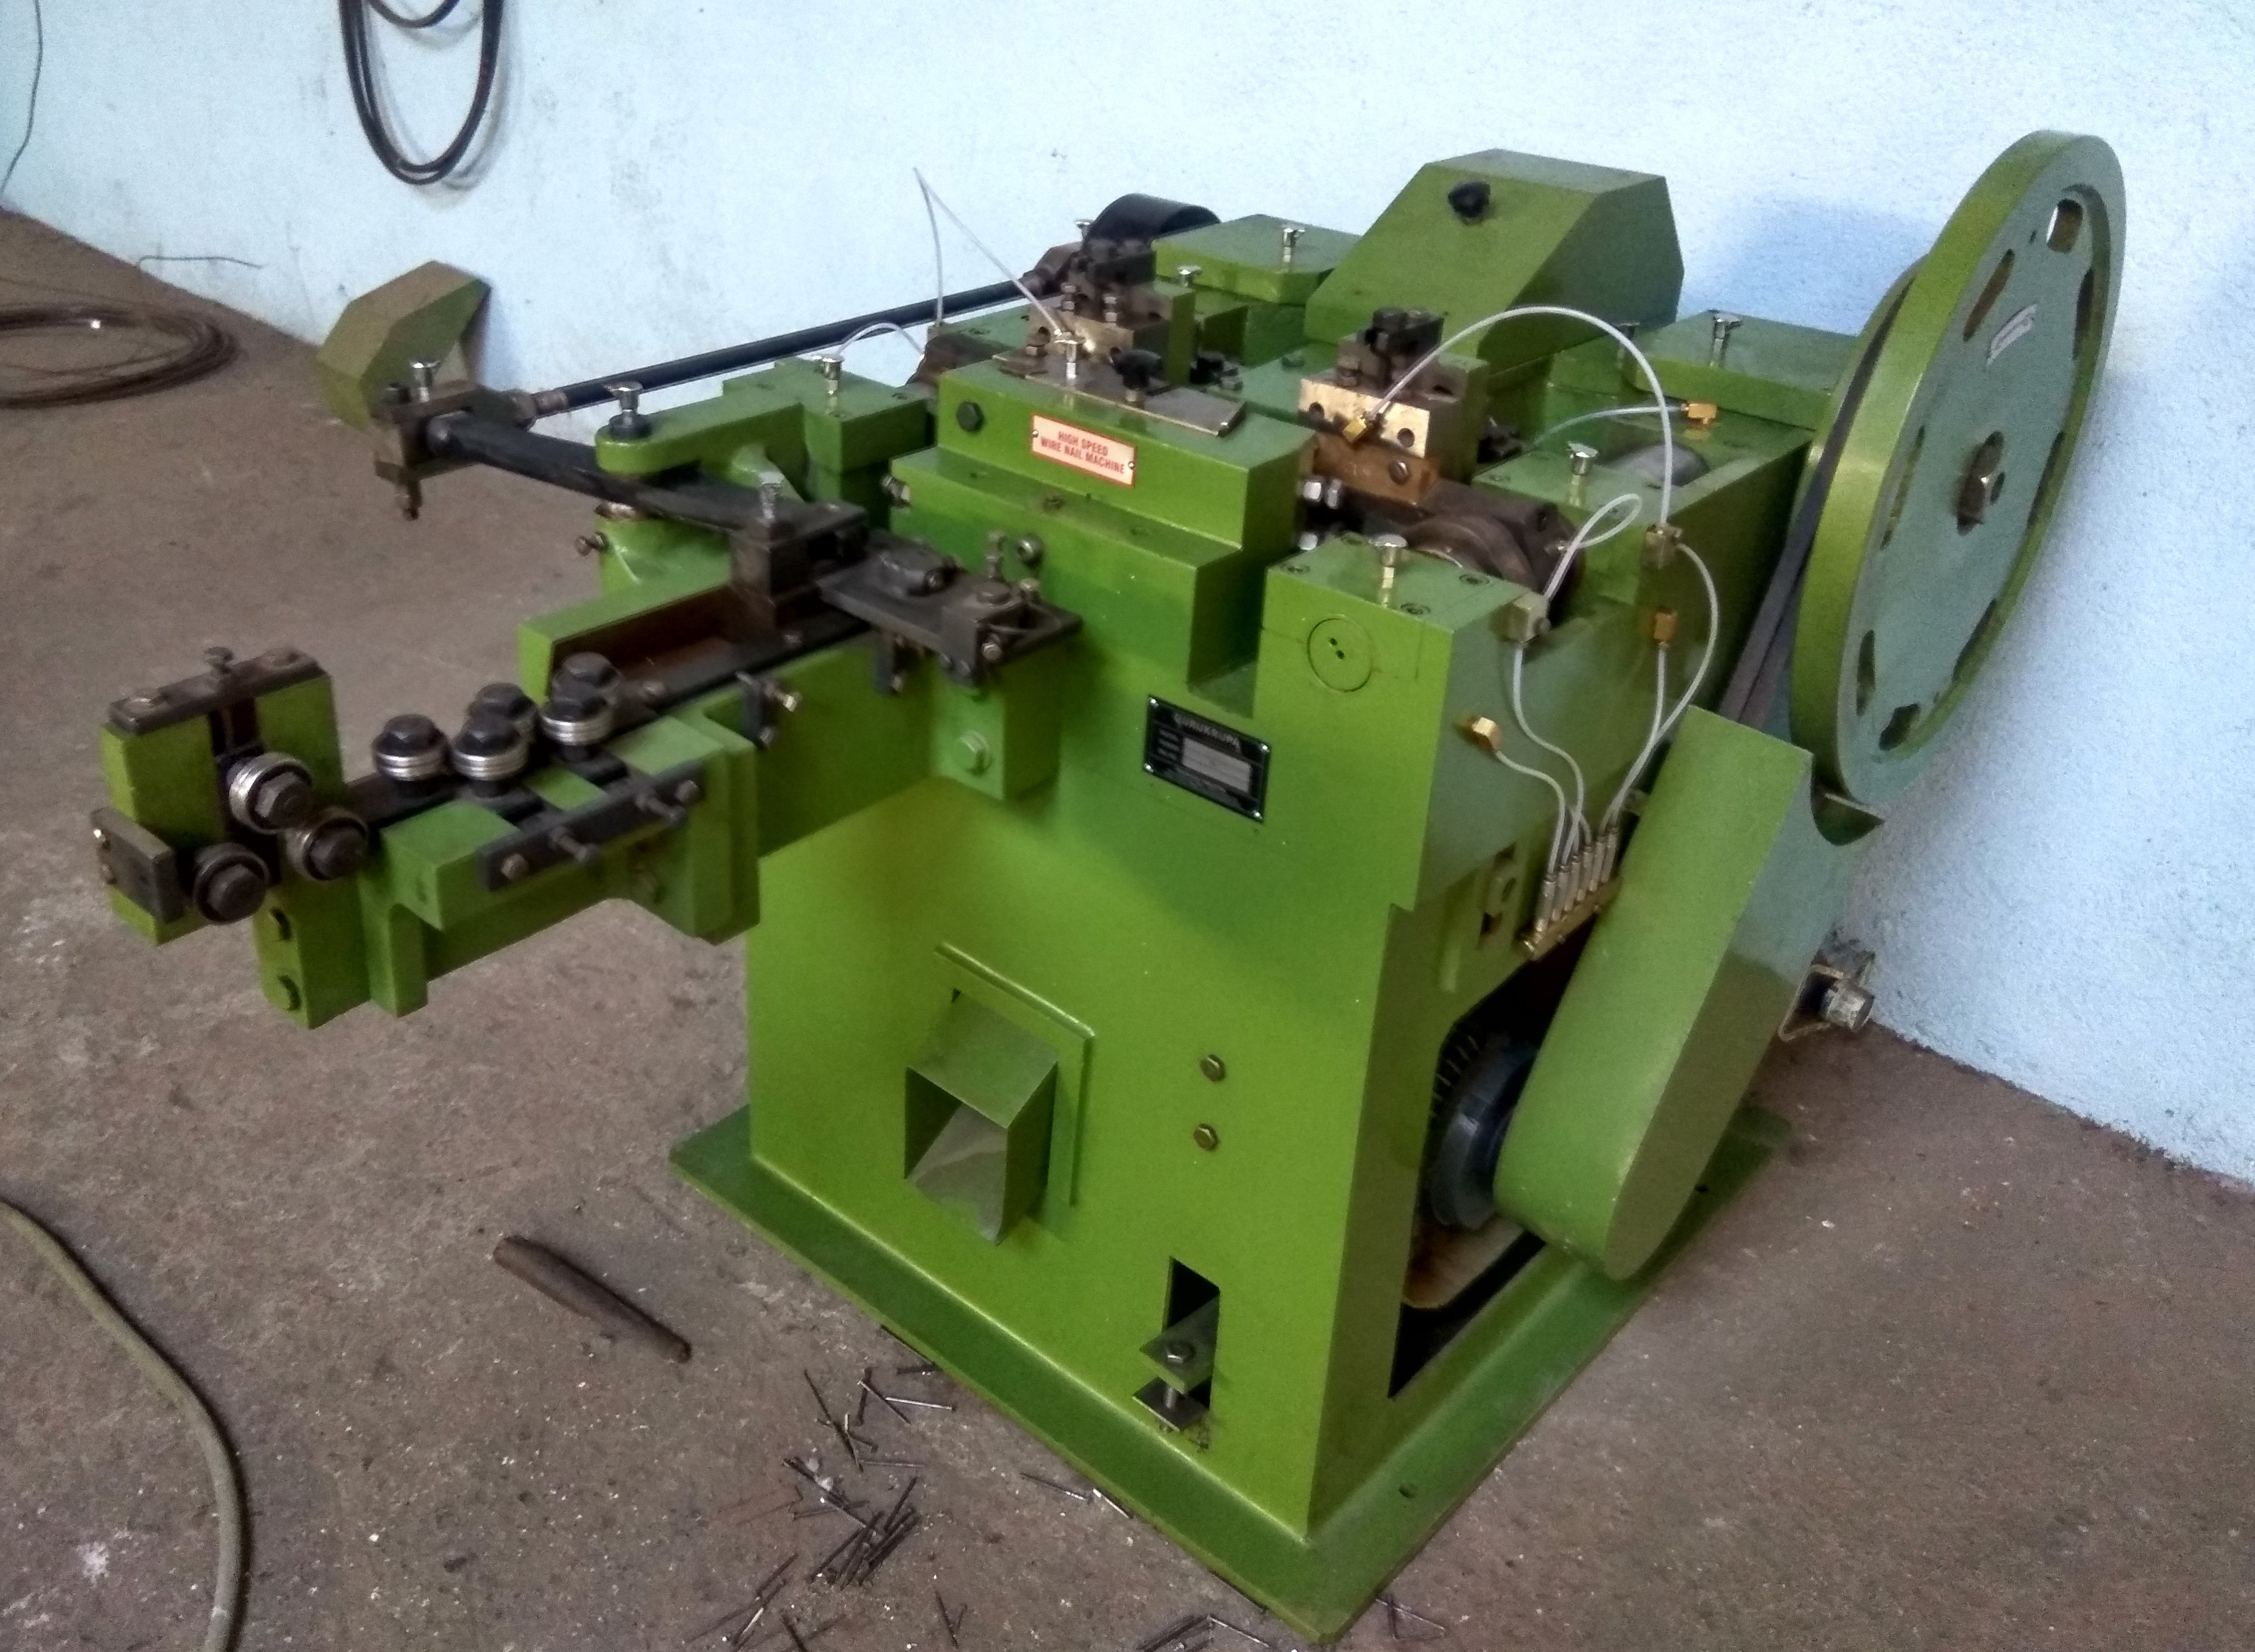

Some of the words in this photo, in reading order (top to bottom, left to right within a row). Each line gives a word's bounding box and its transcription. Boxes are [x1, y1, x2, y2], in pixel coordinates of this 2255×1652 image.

[1041, 437, 1061, 452] WIRE
[1064, 445, 1082, 460] NAIL
[1085, 452, 1125, 473] MACHINE
[1059, 431, 1079, 445] HIGH
[1081, 439, 1108, 456] SPEED
